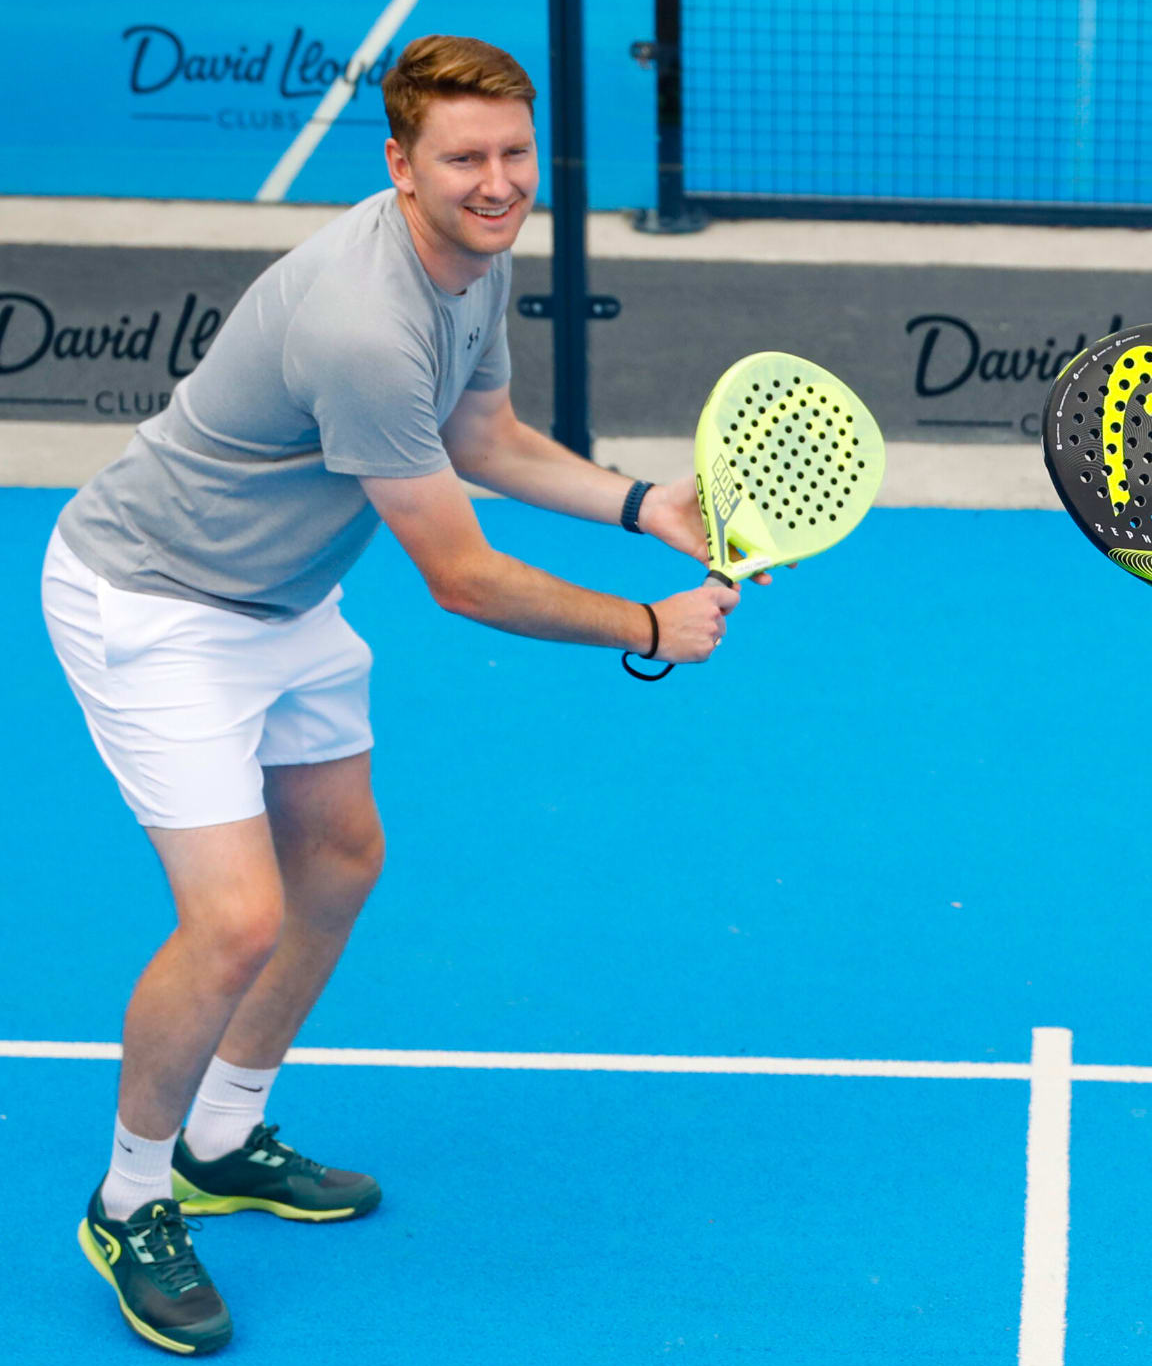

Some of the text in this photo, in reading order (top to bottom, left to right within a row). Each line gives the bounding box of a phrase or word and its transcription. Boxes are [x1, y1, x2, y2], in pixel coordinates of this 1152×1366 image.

[122, 24, 273, 94] David
[216, 109, 299, 132] CLUBS
[0, 292, 161, 376] David
[711, 453, 742, 508] BOLT
[711, 478, 732, 521] PRO
